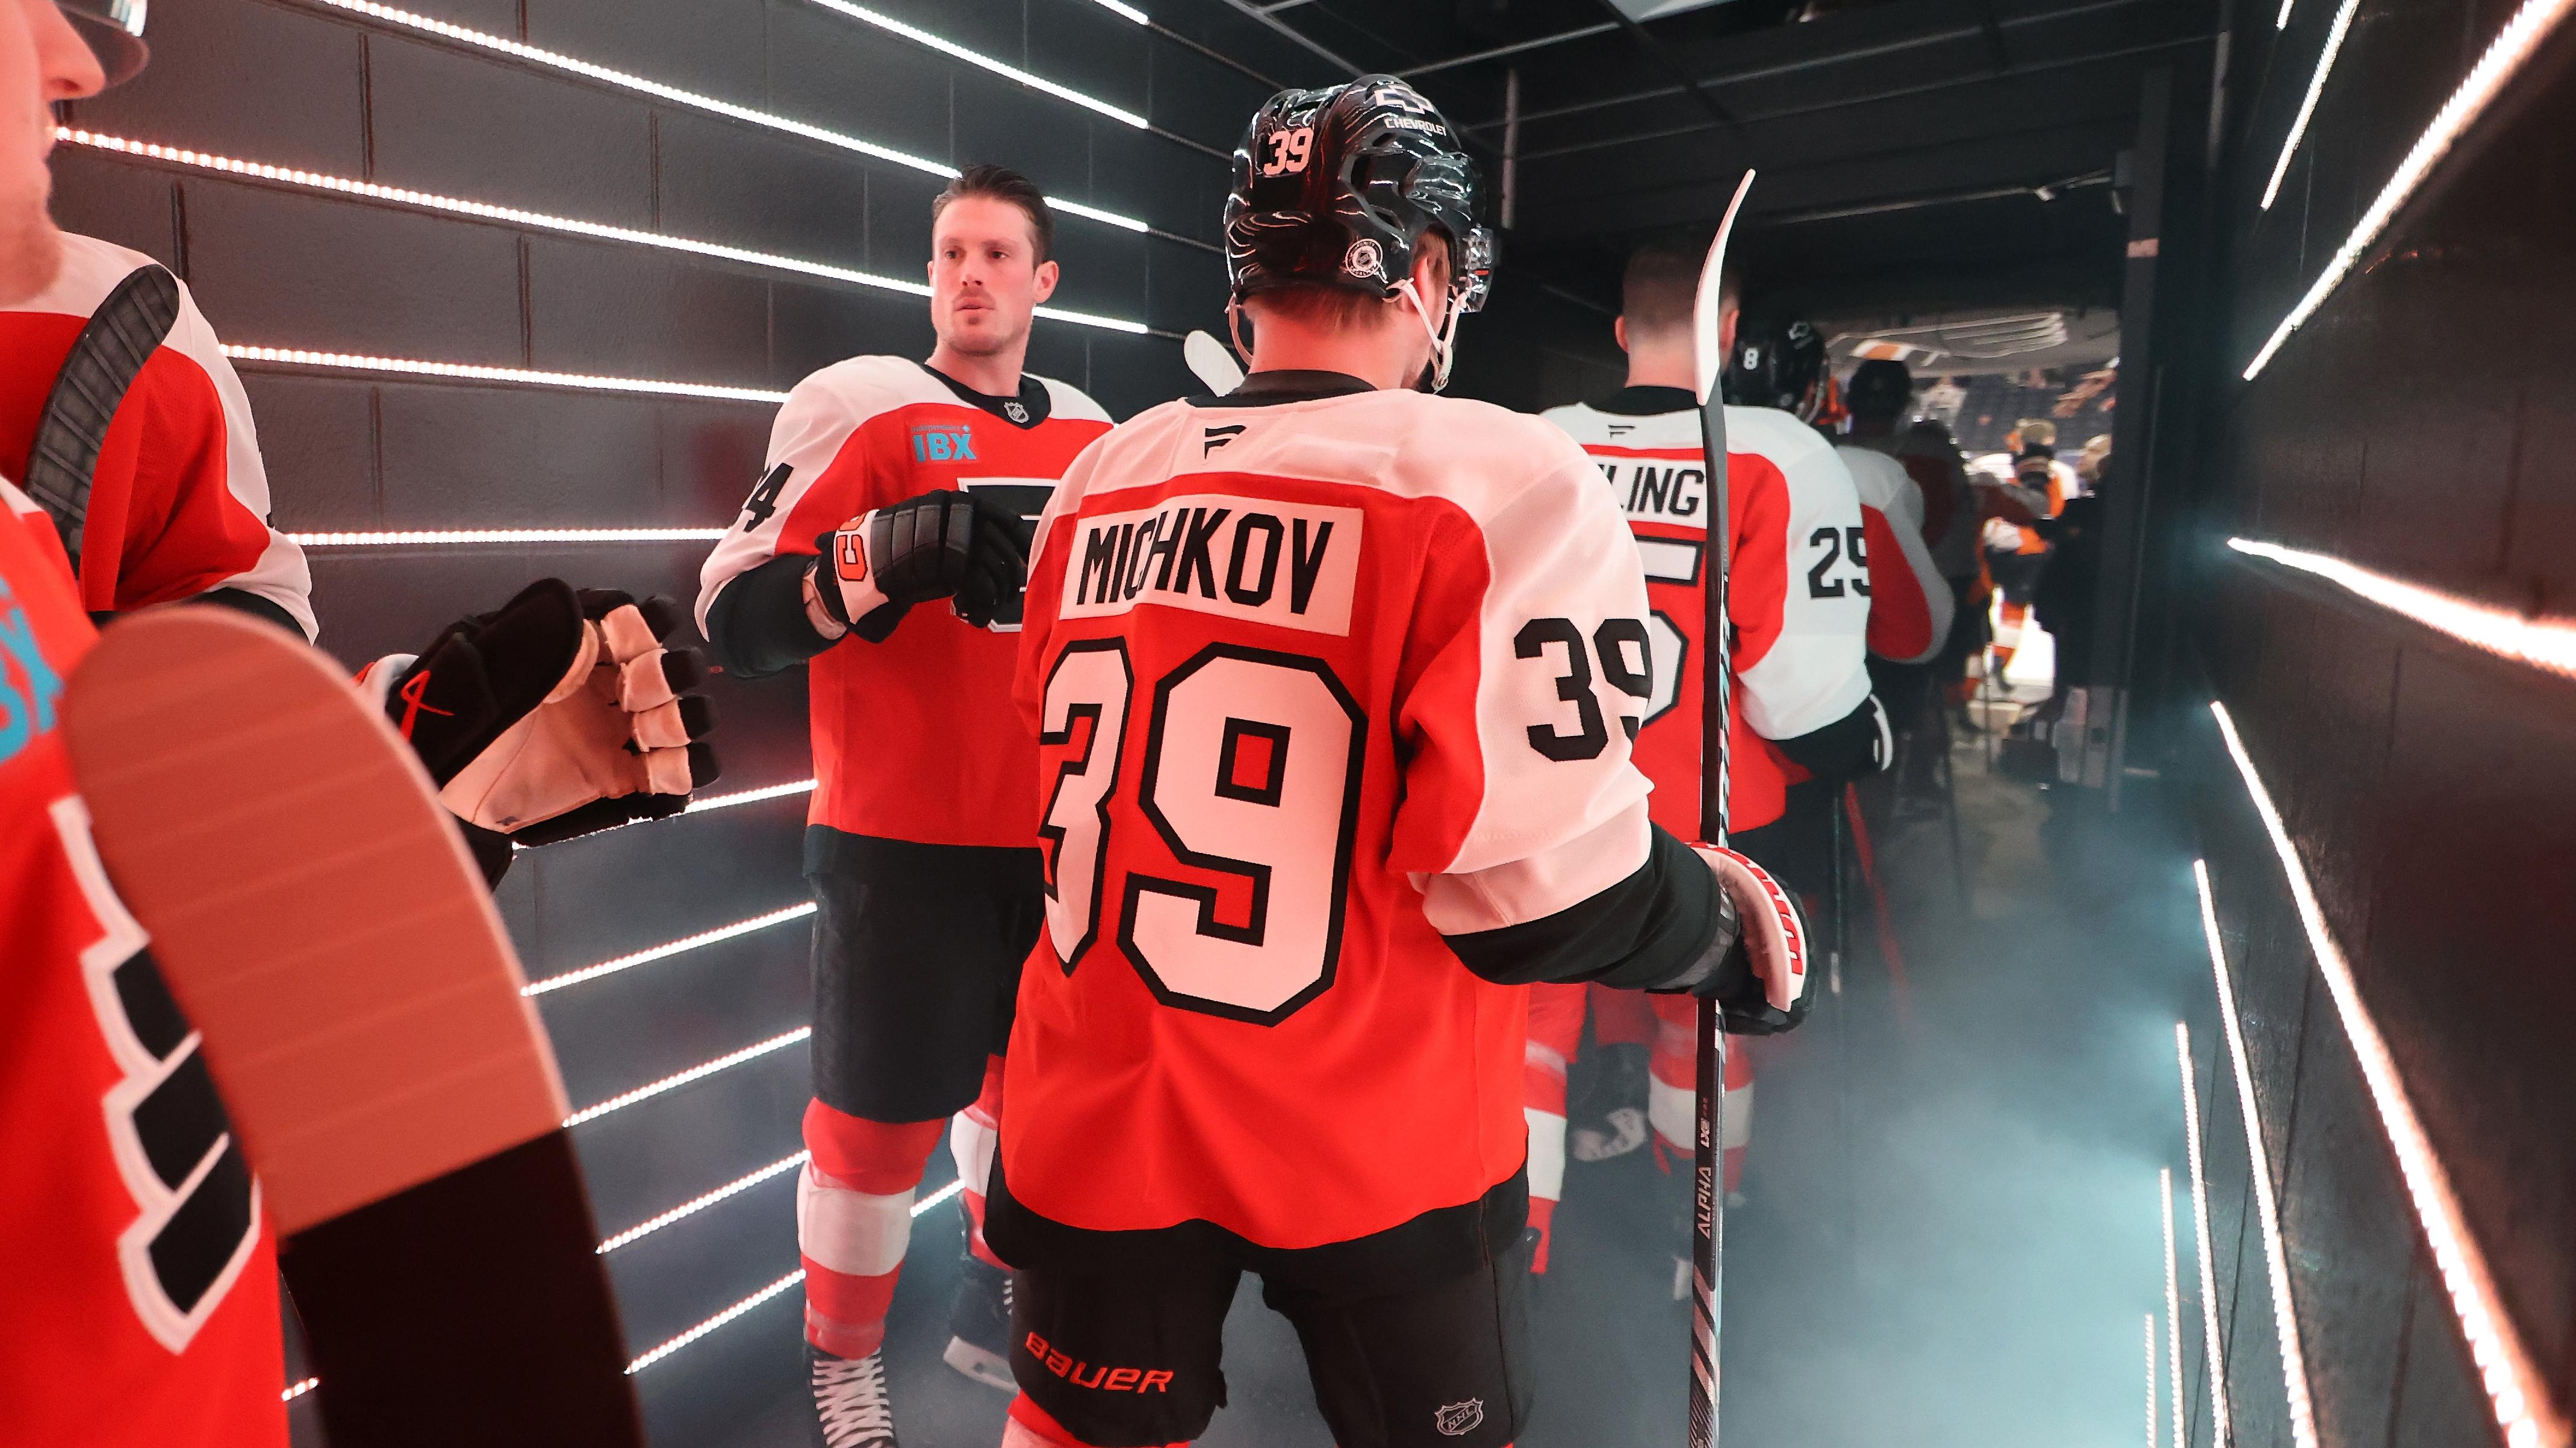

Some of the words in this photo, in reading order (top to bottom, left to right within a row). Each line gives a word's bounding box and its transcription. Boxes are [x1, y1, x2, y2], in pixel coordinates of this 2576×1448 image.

[1265, 128, 1314, 175] 39
[1384, 117, 1446, 136] CHEVROLET
[1744, 348, 1758, 370] 8
[913, 433, 977, 463] IBX
[1076, 508, 1333, 615] MICHKOV
[1513, 618, 1653, 761] 39
[1037, 636, 1369, 1026] 39
[1697, 1167, 1711, 1240] ALPHA
